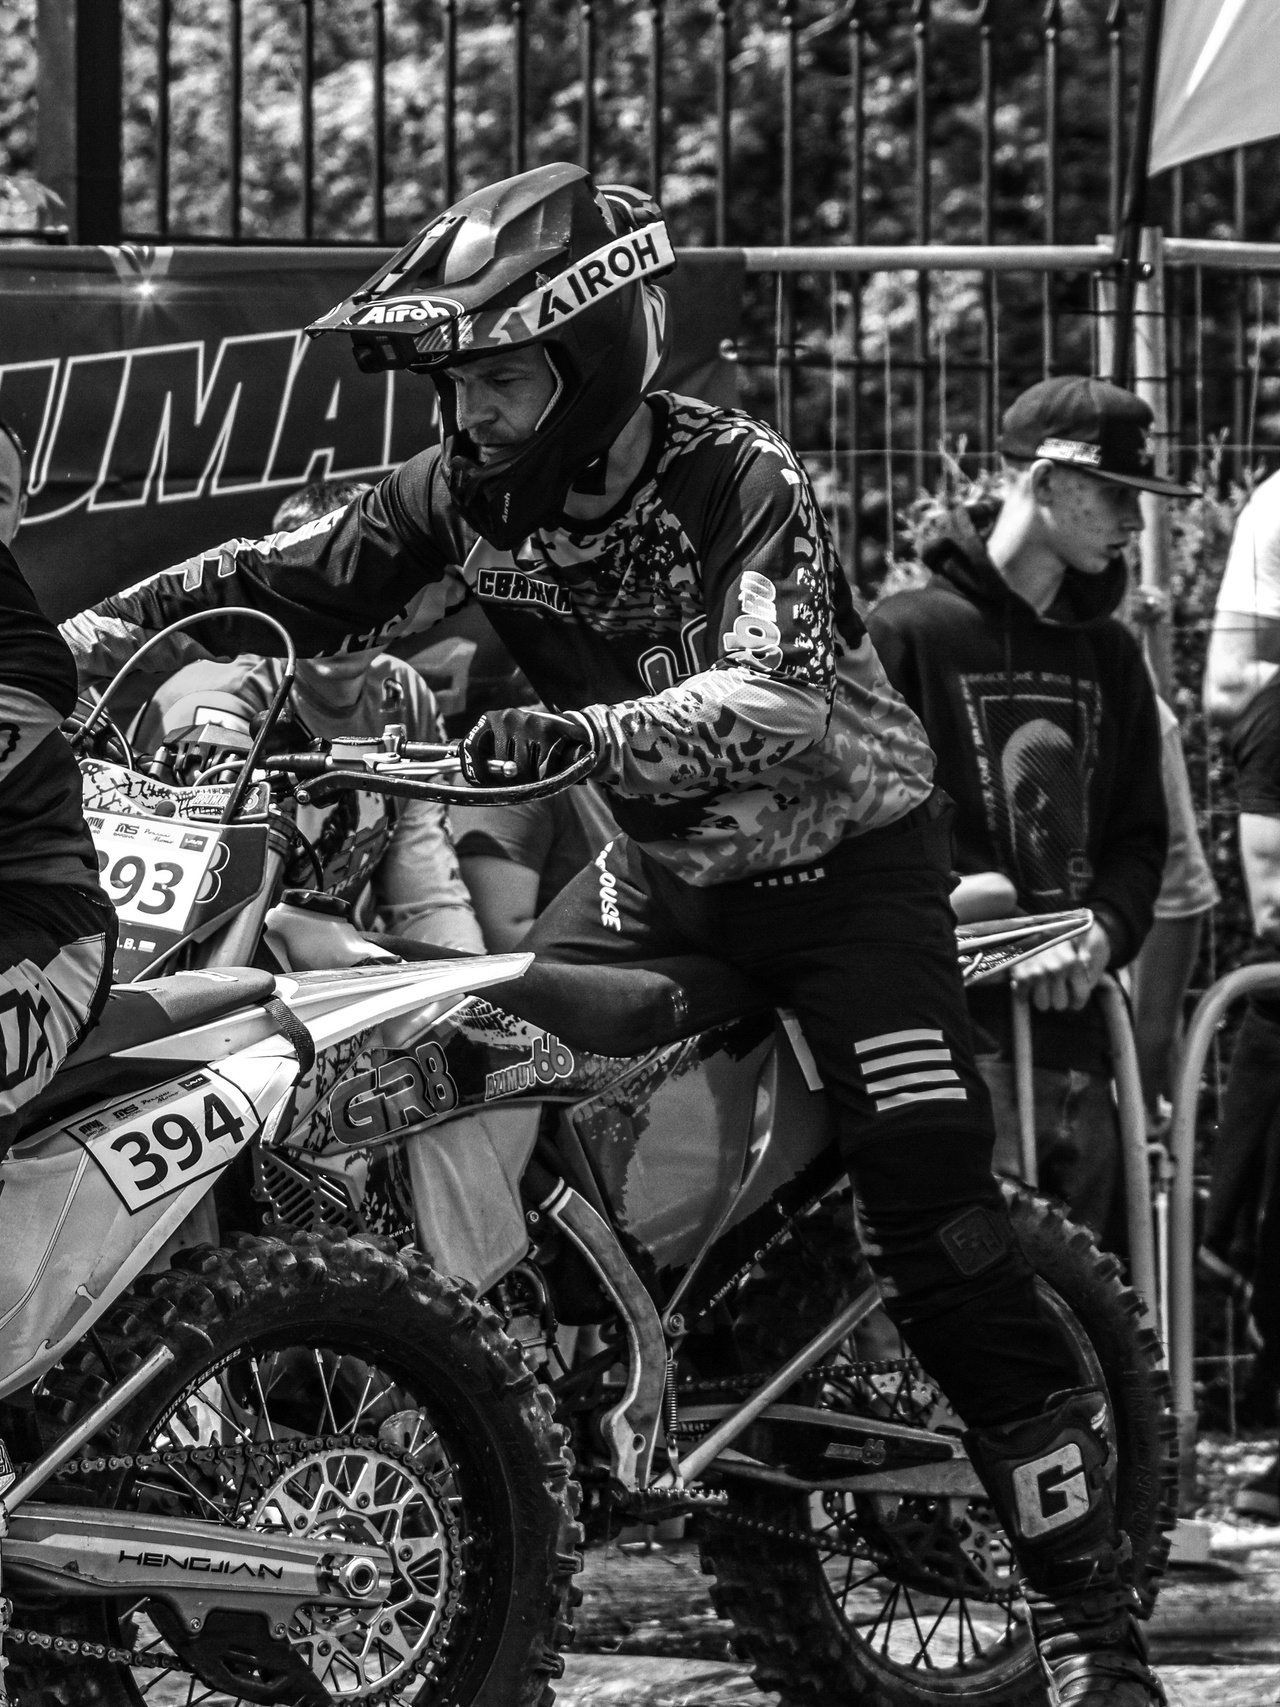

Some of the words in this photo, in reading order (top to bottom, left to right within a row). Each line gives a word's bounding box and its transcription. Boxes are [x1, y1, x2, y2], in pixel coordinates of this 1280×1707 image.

[357, 300, 451, 325] Airoh
[537, 232, 660, 331] AIROH
[485, 1062, 537, 1101] AZIMUT
[532, 1033, 575, 1085] 66
[110, 1092, 245, 1191] 394
[1012, 1442, 1090, 1539] G
[119, 1550, 283, 1579] HENGJIAN
